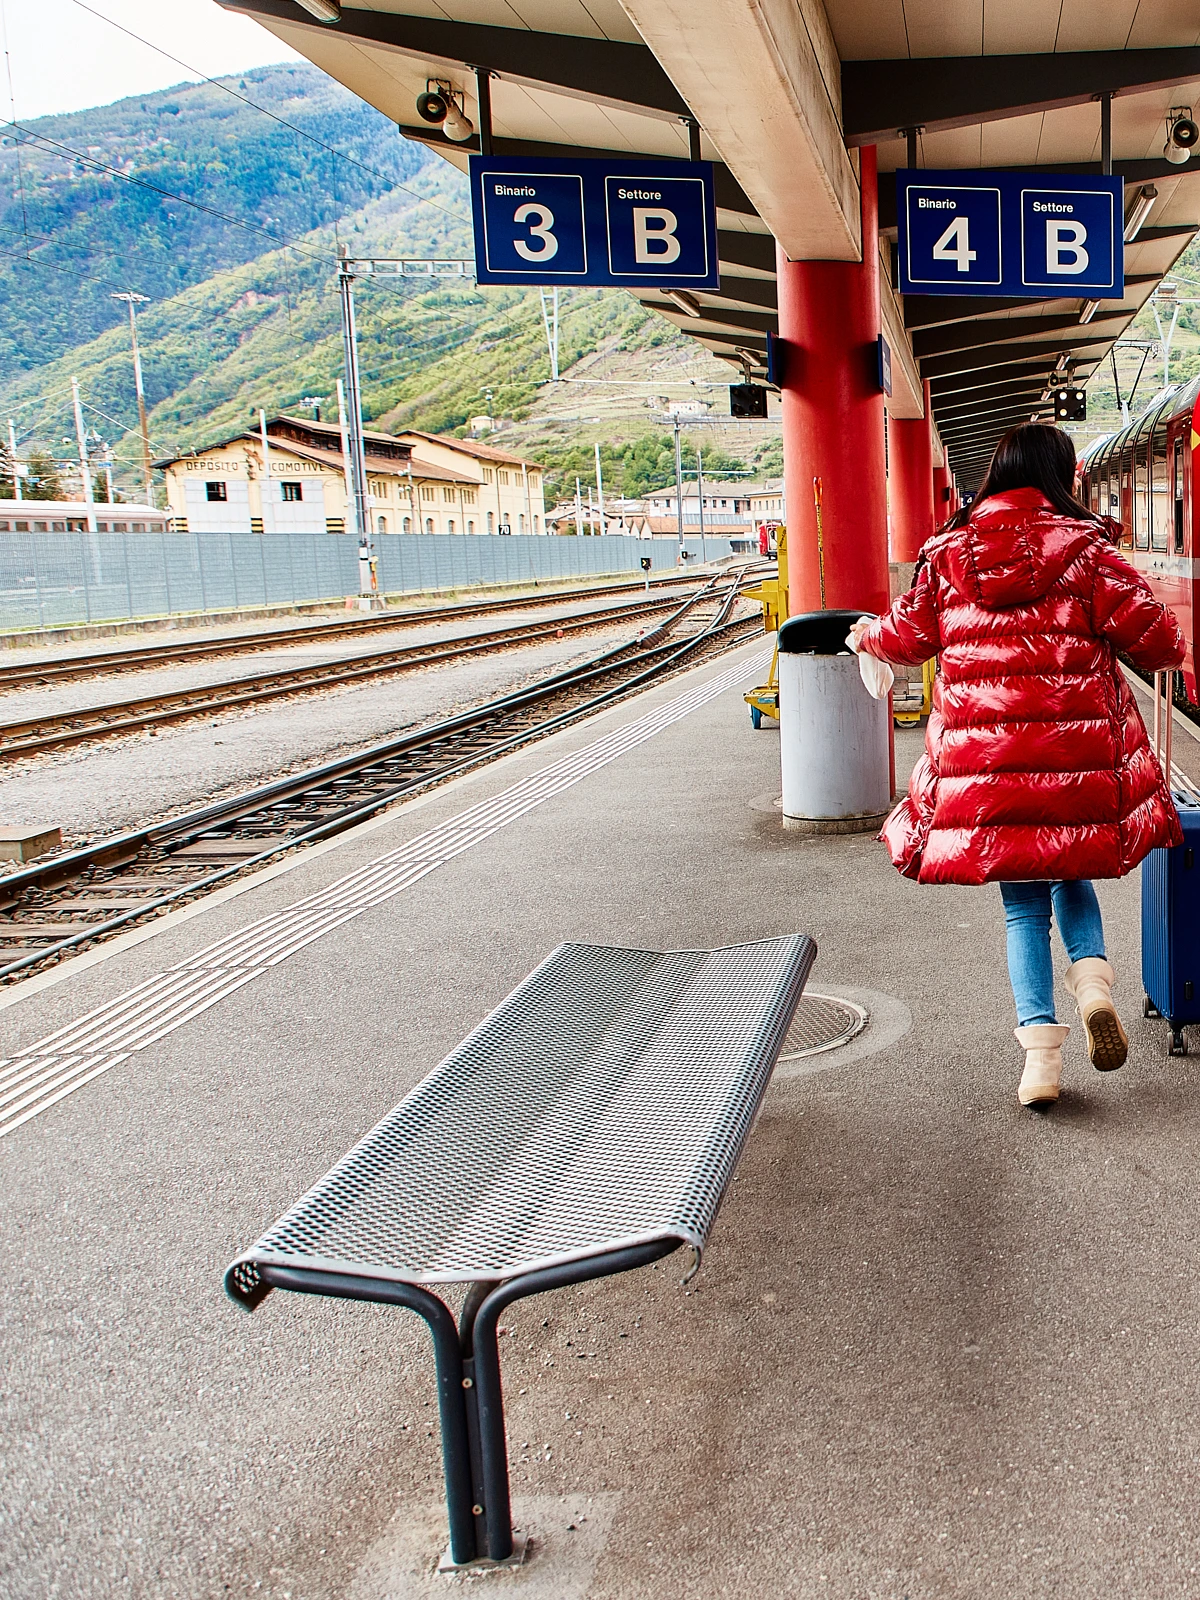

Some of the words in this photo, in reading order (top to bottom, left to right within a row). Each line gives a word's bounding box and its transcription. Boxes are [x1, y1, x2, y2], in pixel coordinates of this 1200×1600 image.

[494, 184, 536, 197] Binario
[617, 188, 662, 201] Settore
[918, 197, 957, 210] Binario
[1032, 201, 1074, 214] Settore
[513, 203, 559, 263] 3
[632, 207, 681, 264] B
[932, 216, 977, 272] 4
[1045, 219, 1090, 275] B
[186, 461, 239, 471] DEPOSITO
[257, 462, 326, 472] LCOMOTIVE
[499, 525, 510, 535] 70
